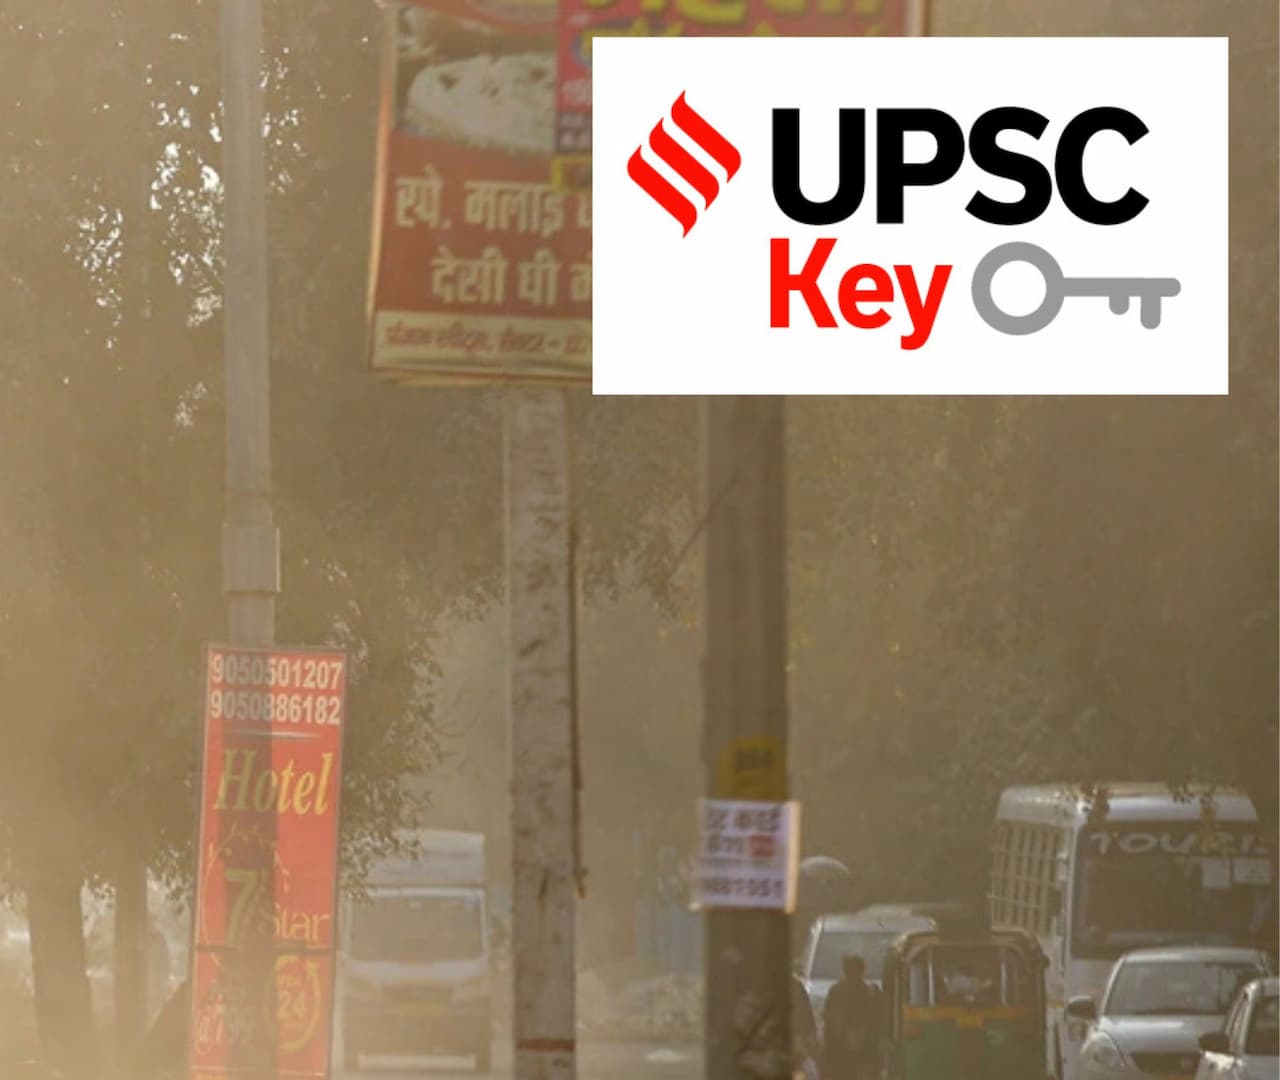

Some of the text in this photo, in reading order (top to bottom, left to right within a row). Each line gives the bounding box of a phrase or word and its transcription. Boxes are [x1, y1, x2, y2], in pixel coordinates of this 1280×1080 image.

[210, 653, 342, 690] 9050501207
[210, 689, 340, 725] 9050886182
[213, 749, 333, 816] Hotel
